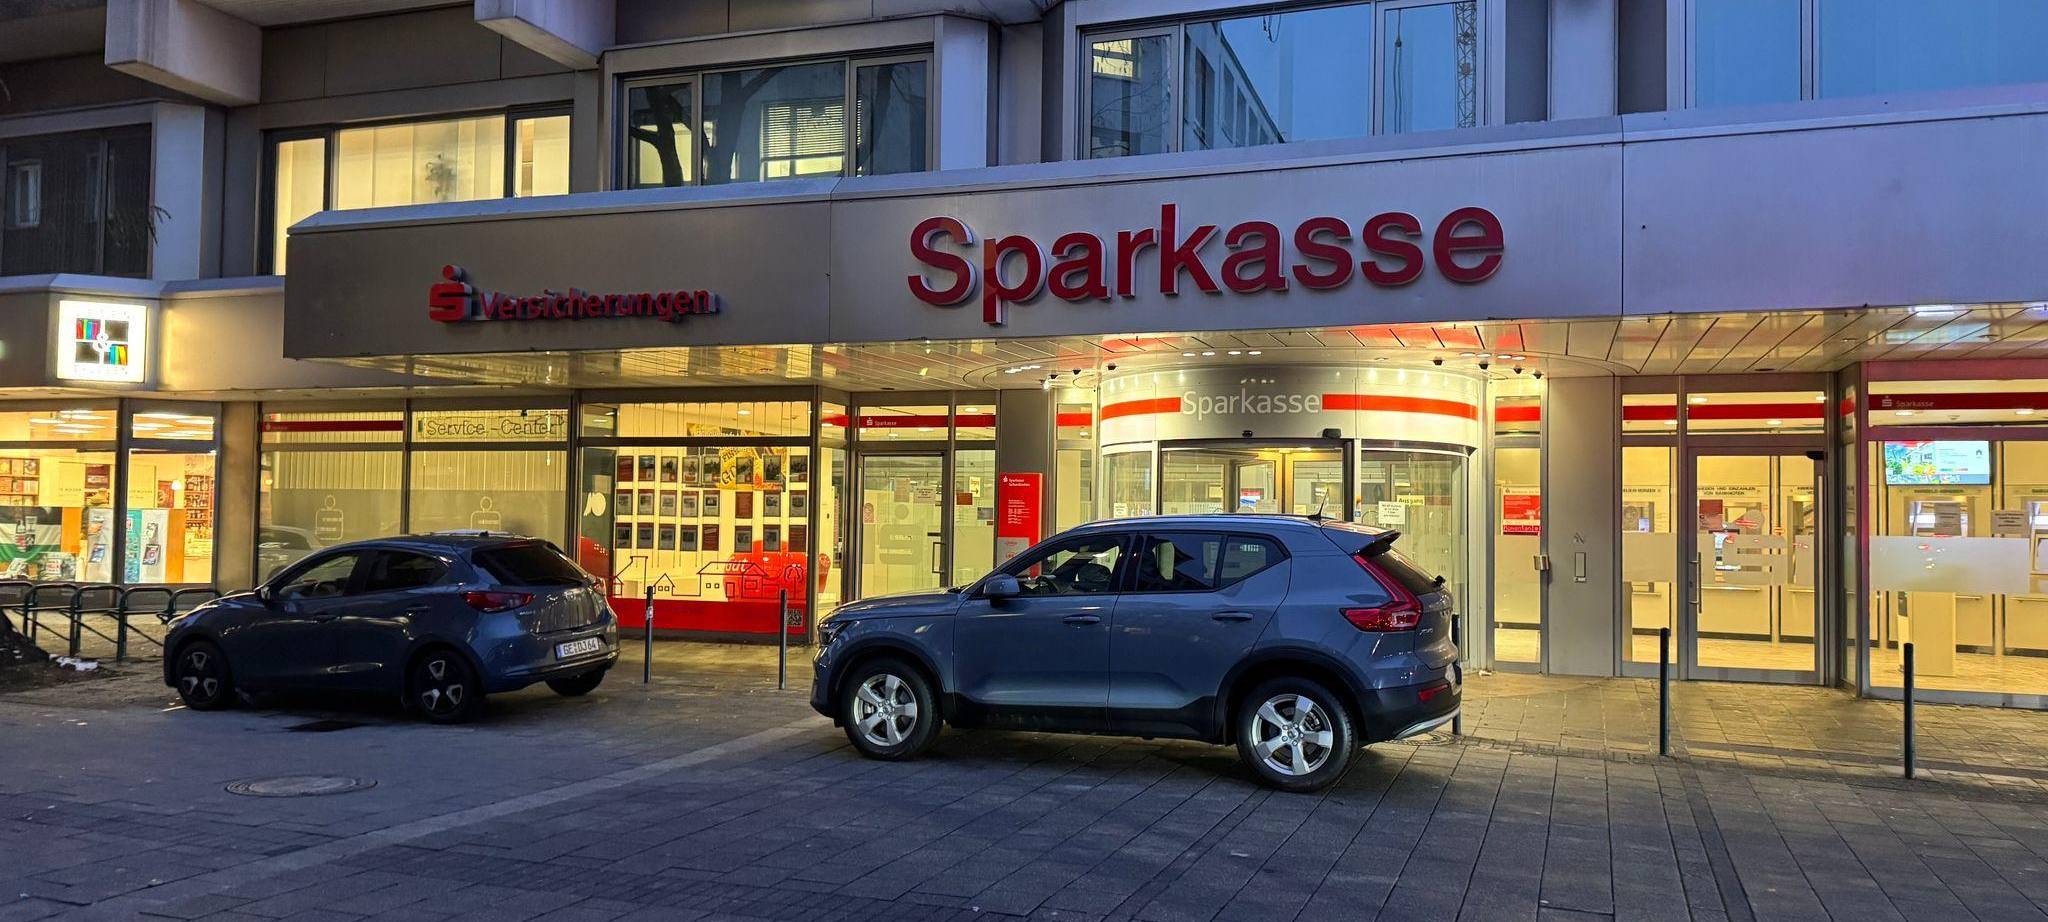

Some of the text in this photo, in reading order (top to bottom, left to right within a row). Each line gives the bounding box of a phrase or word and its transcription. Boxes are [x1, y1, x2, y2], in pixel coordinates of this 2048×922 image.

[907, 203, 1505, 325] Sparkasse
[479, 287, 719, 323] Versicherungen
[1182, 389, 1322, 421] Sparkasse
[426, 419, 486, 436] Service
[500, 418, 557, 435] Center
